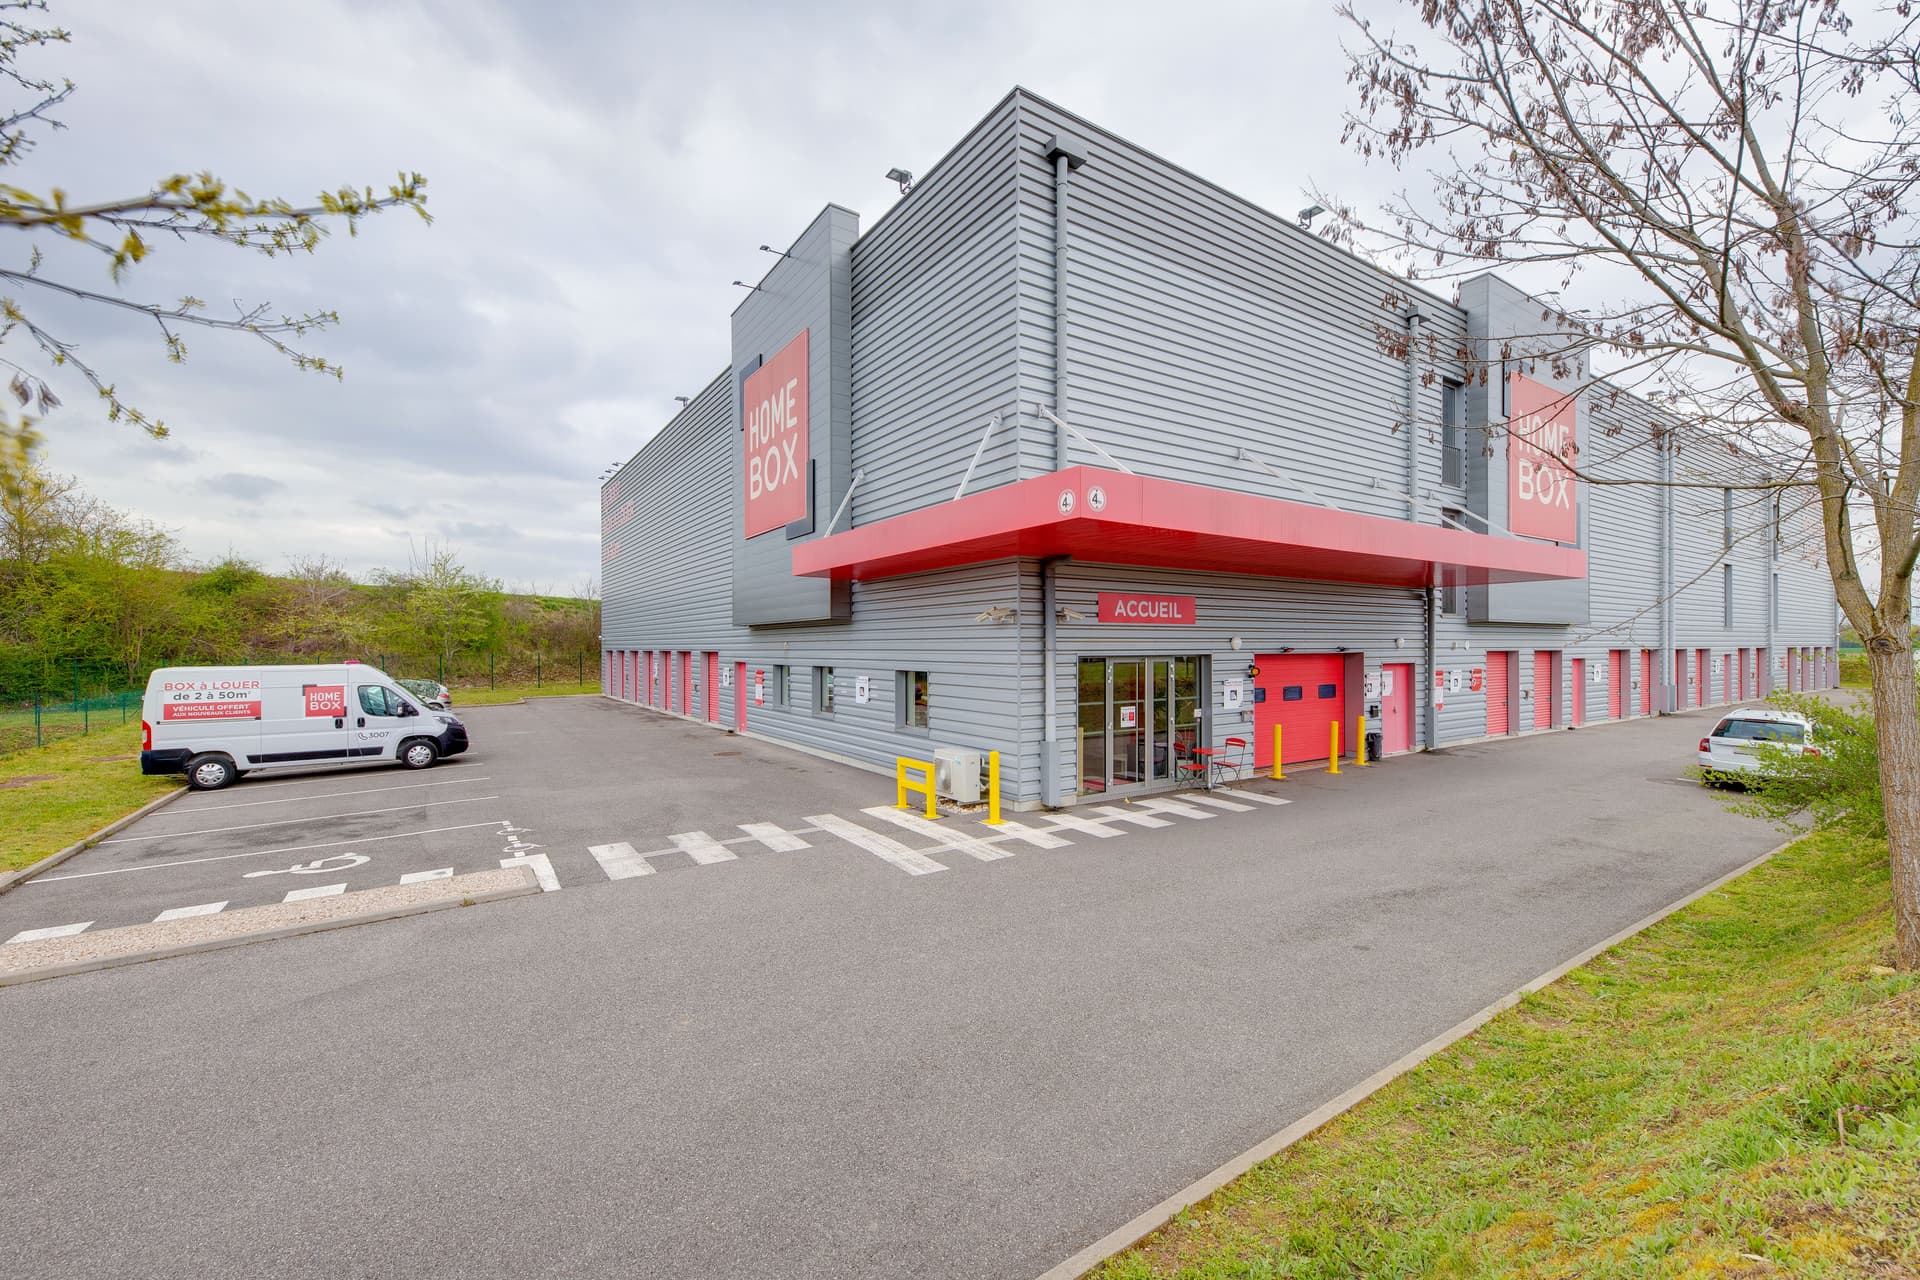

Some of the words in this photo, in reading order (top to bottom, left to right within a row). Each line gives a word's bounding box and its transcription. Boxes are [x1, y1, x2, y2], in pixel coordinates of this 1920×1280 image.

[750, 377, 797, 452] HOME
[1519, 410, 1569, 466] HOME
[750, 432, 798, 500] BOX
[1519, 458, 1569, 510] BOX
[1114, 600, 1182, 618] ACCUEIL
[164, 682, 195, 691] BOX
[200, 681, 207, 690] à
[212, 681, 260, 690] LOUER
[173, 692, 190, 701] de
[195, 692, 202, 700] 2
[207, 691, 214, 700] à
[310, 692, 341, 701] HOME
[172, 704, 215, 712] VÉHICULE
[310, 701, 341, 711] BOX
